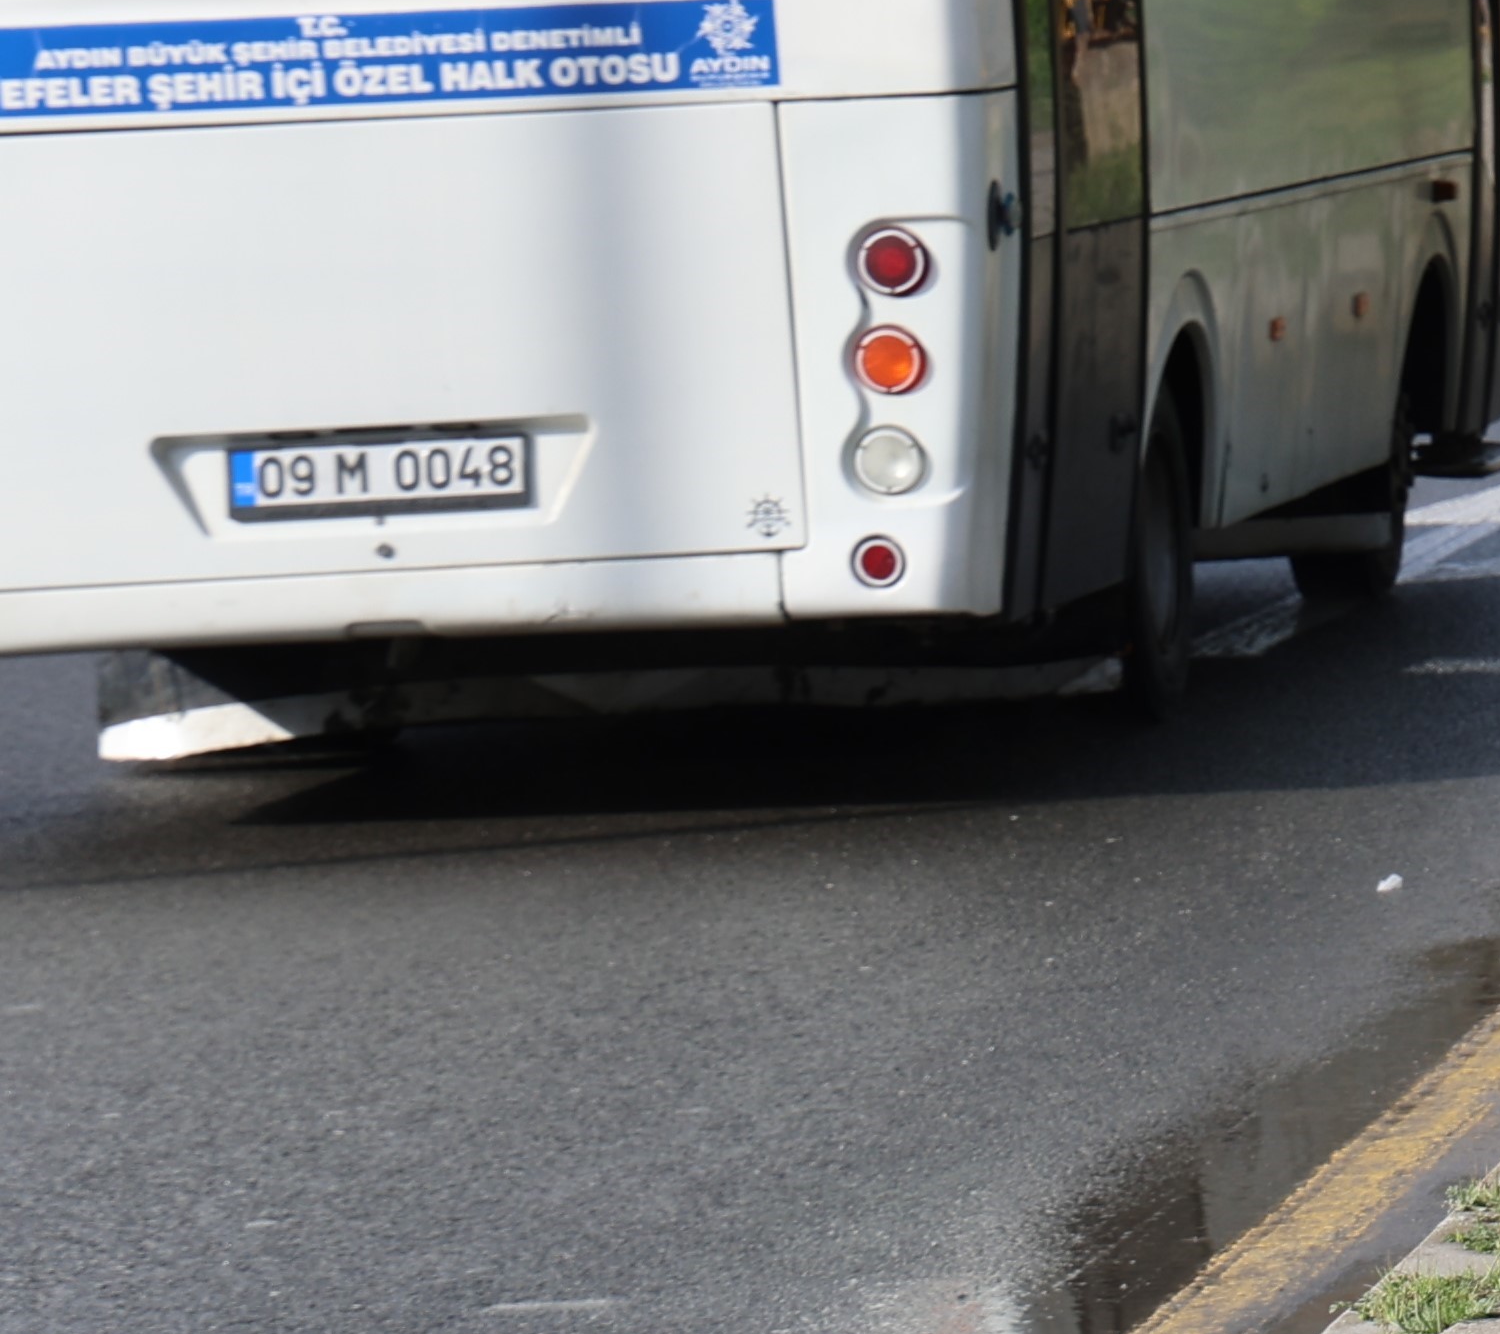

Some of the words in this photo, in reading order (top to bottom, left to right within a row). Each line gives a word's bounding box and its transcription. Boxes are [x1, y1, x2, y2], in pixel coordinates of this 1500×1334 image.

[37, 47, 123, 71] AYDIN
[126, 40, 230, 67] BÜYÜK
[230, 36, 319, 66] ŞEHİR
[321, 28, 487, 60] BELEDİYESİ
[490, 21, 642, 52] DENETİMLİ
[689, 54, 771, 75] AYDIN
[1, 75, 142, 110] EFELER
[147, 66, 265, 110] ŞEHİR
[271, 61, 326, 105] İÇİ
[332, 60, 434, 97] ÖZEL
[438, 59, 545, 92] HALK
[548, 52, 680, 88] OTOSU
[258, 455, 317, 499] 09
[335, 452, 369, 495] M
[393, 444, 516, 492] 0048
